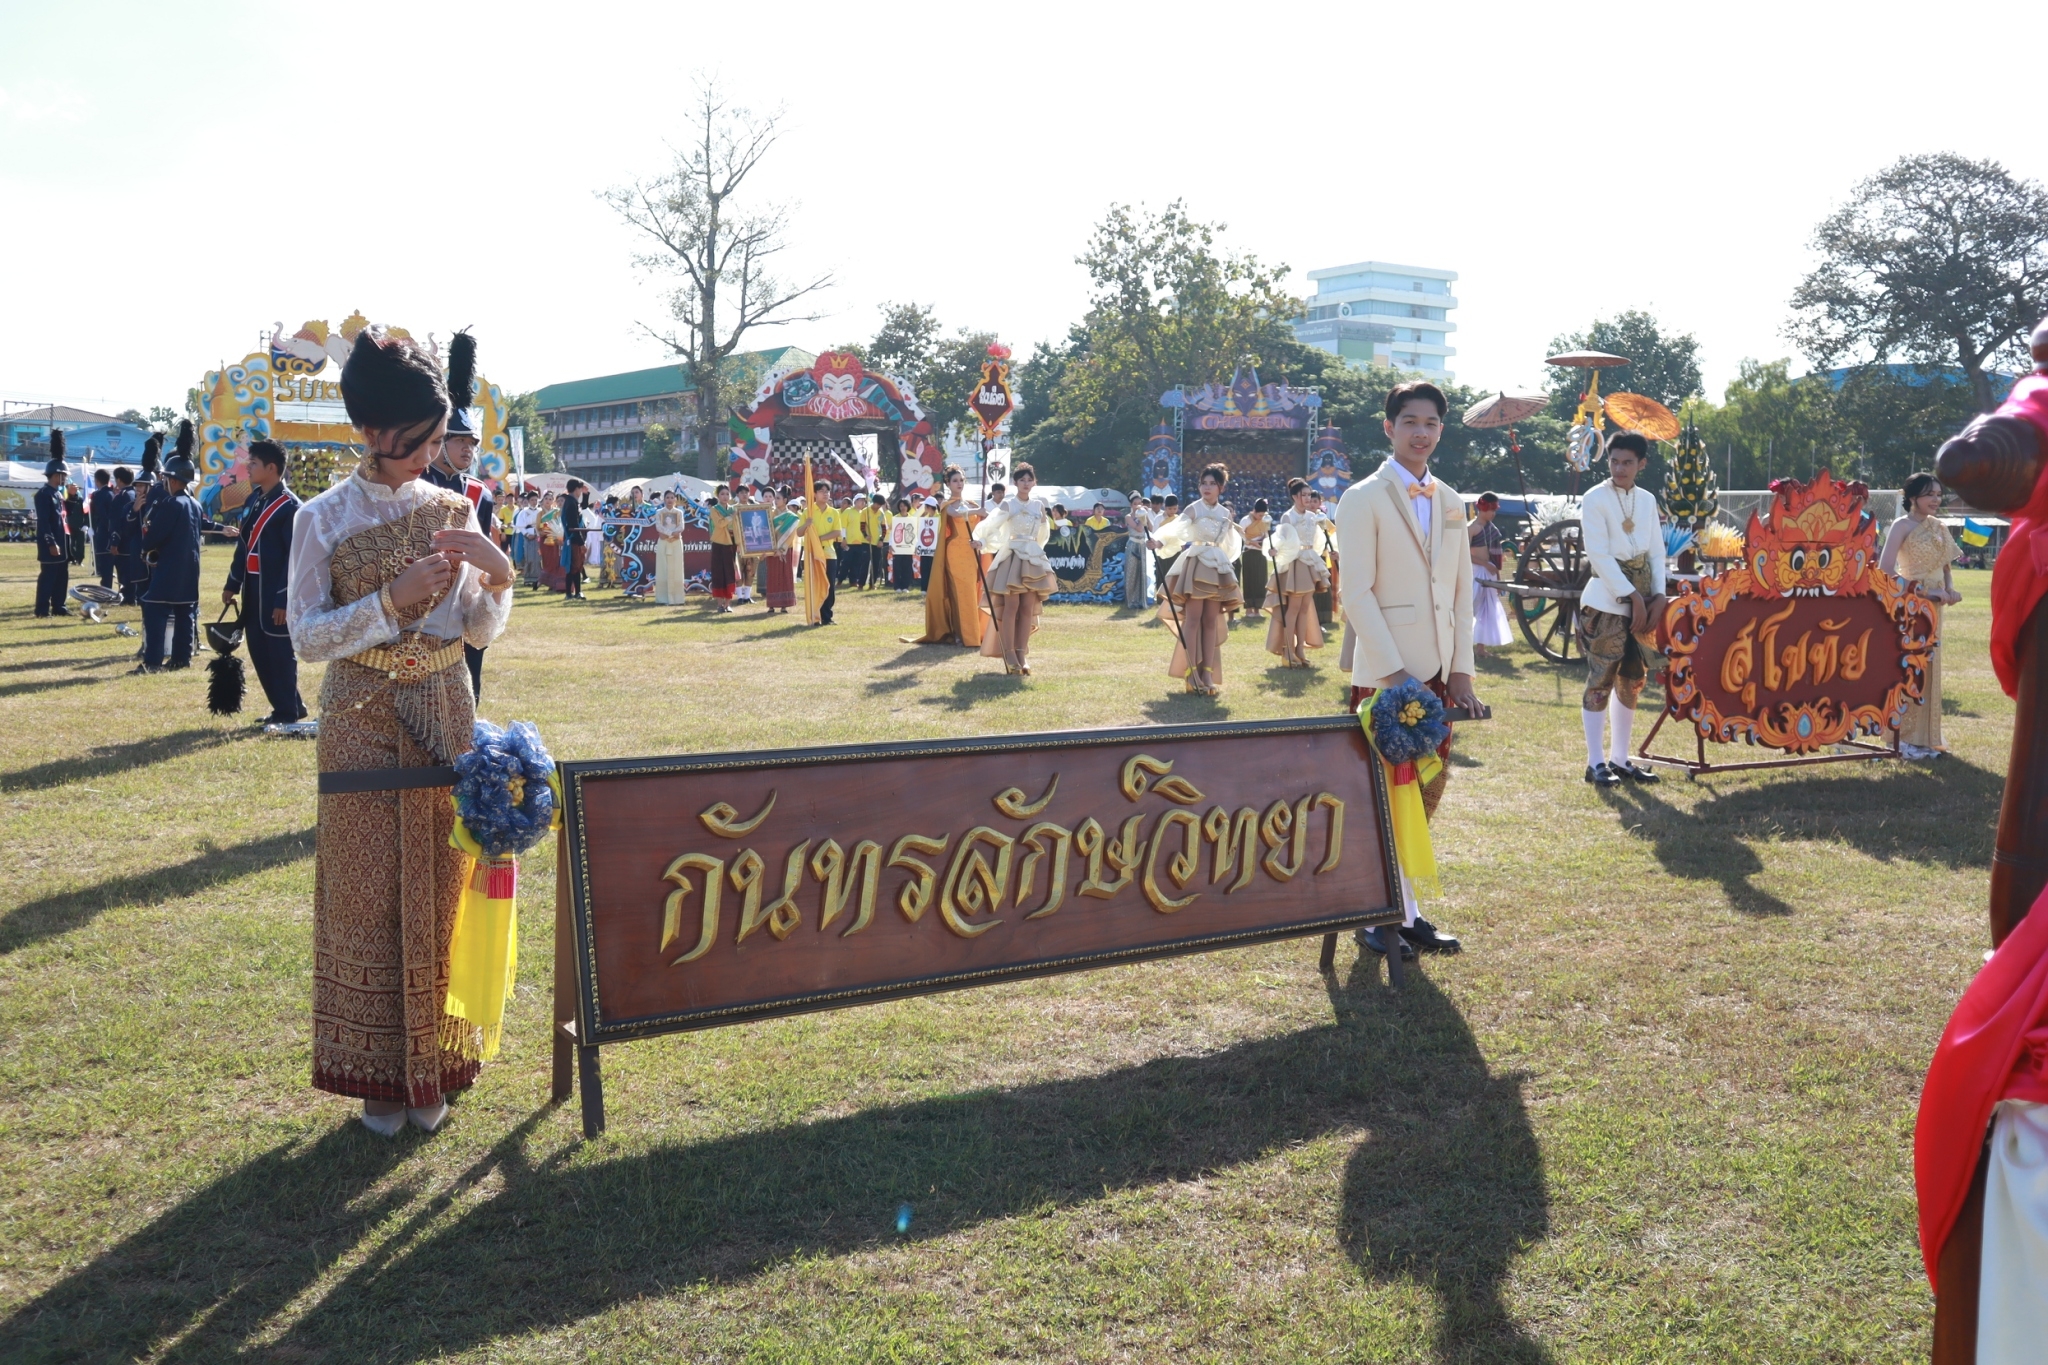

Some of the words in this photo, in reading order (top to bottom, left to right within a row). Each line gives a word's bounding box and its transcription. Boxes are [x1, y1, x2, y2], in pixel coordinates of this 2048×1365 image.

[924, 519, 933, 527] NO
[1720, 599, 1874, 714] สุโขทัย
[660, 754, 1346, 966] กันทรลักษ์วิทยา
